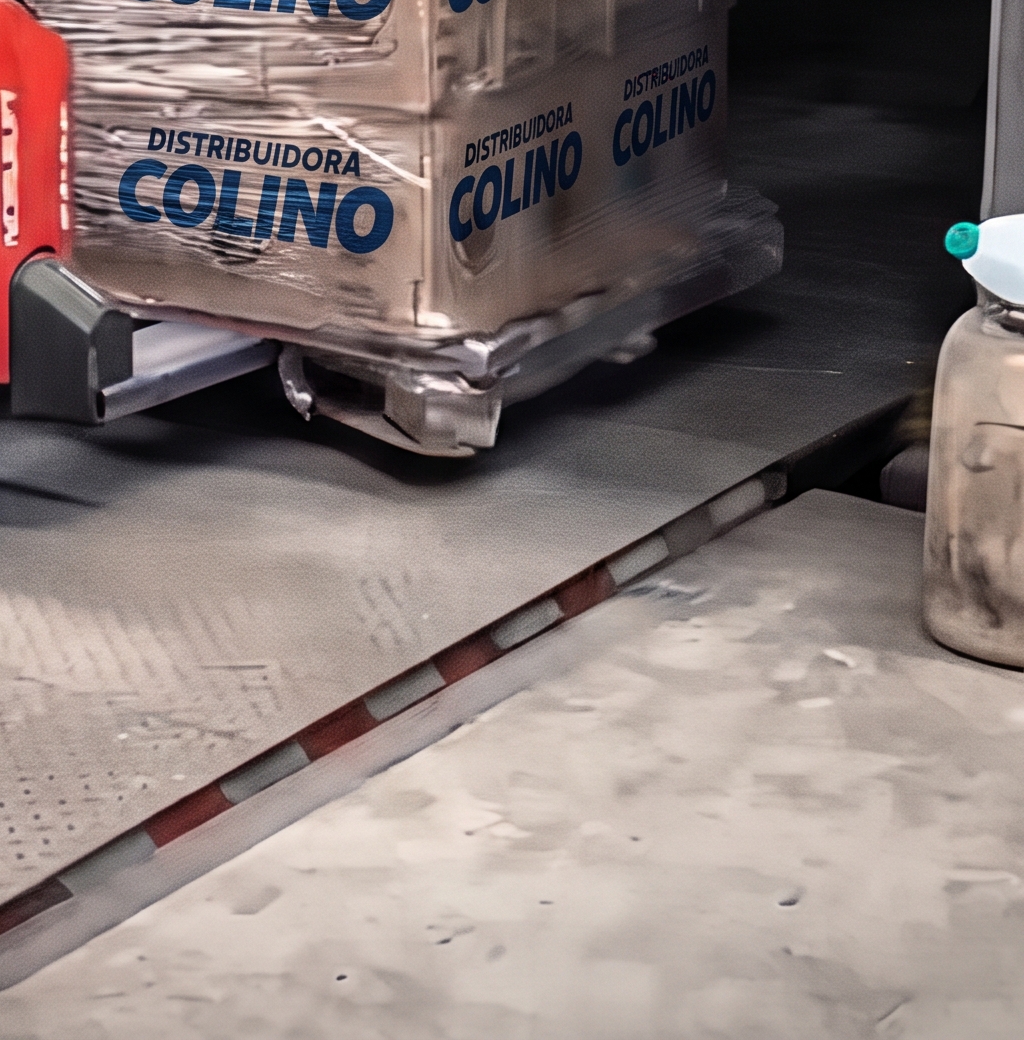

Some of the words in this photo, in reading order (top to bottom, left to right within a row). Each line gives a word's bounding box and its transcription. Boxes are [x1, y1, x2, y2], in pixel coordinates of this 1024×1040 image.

[623, 44, 710, 102] DISTRIBUIDORA
[147, 127, 361, 177] DISTRIBUIDORA
[464, 101, 574, 168] DISTRIBUIDORA
[612, 69, 717, 167] COLINO
[117, 157, 395, 255] COLINO
[449, 130, 584, 243] COLINO
